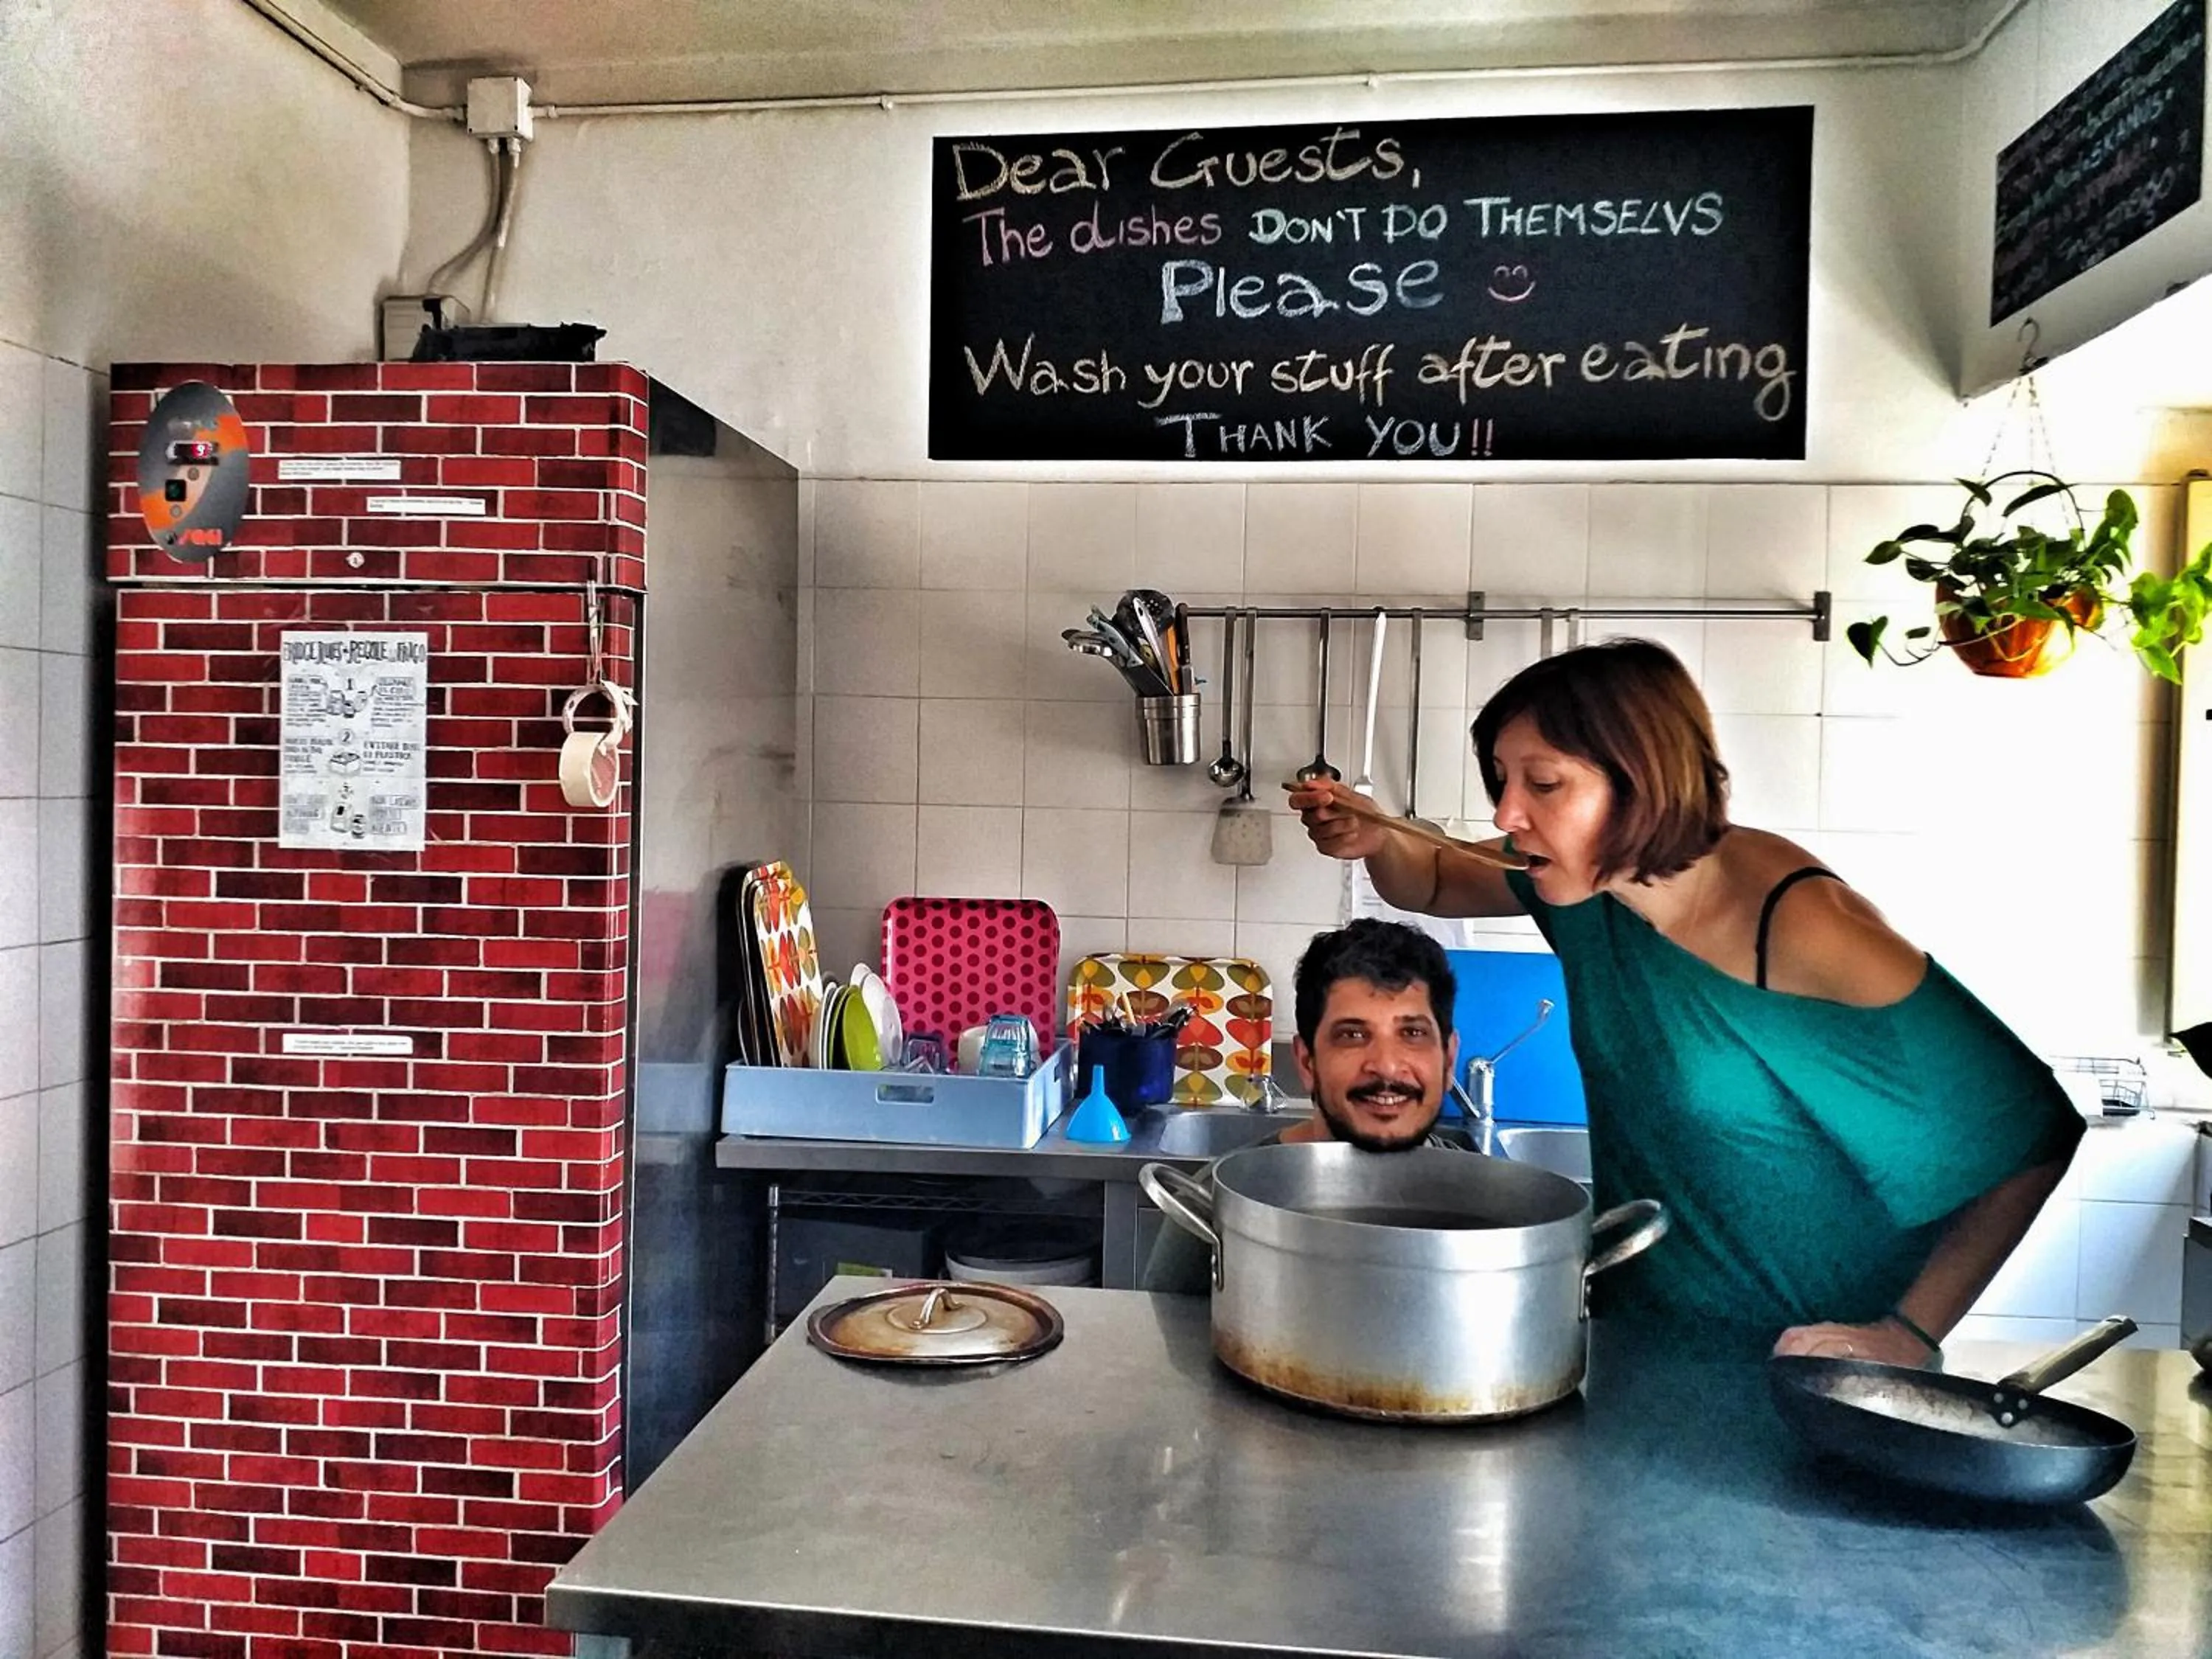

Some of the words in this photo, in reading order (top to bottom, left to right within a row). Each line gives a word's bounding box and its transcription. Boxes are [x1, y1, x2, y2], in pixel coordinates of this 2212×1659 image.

[953, 140, 1125, 201] Dear
[1150, 127, 1420, 189] Guests,
[963, 207, 1053, 266] The
[1070, 201, 1222, 254] dishes
[1248, 207, 1366, 244] DON'T
[1382, 204, 1447, 244] DO
[1464, 192, 1724, 238] THEMSELVS
[1160, 259, 1444, 324] Please
[964, 333, 1127, 397] Wash
[1138, 359, 1255, 408] your
[1270, 343, 1395, 407] stuff
[1417, 334, 1566, 406] after
[1580, 322, 1797, 422] eating
[1154, 412, 1333, 458] THANK
[1366, 415, 1494, 457] YOU!!
